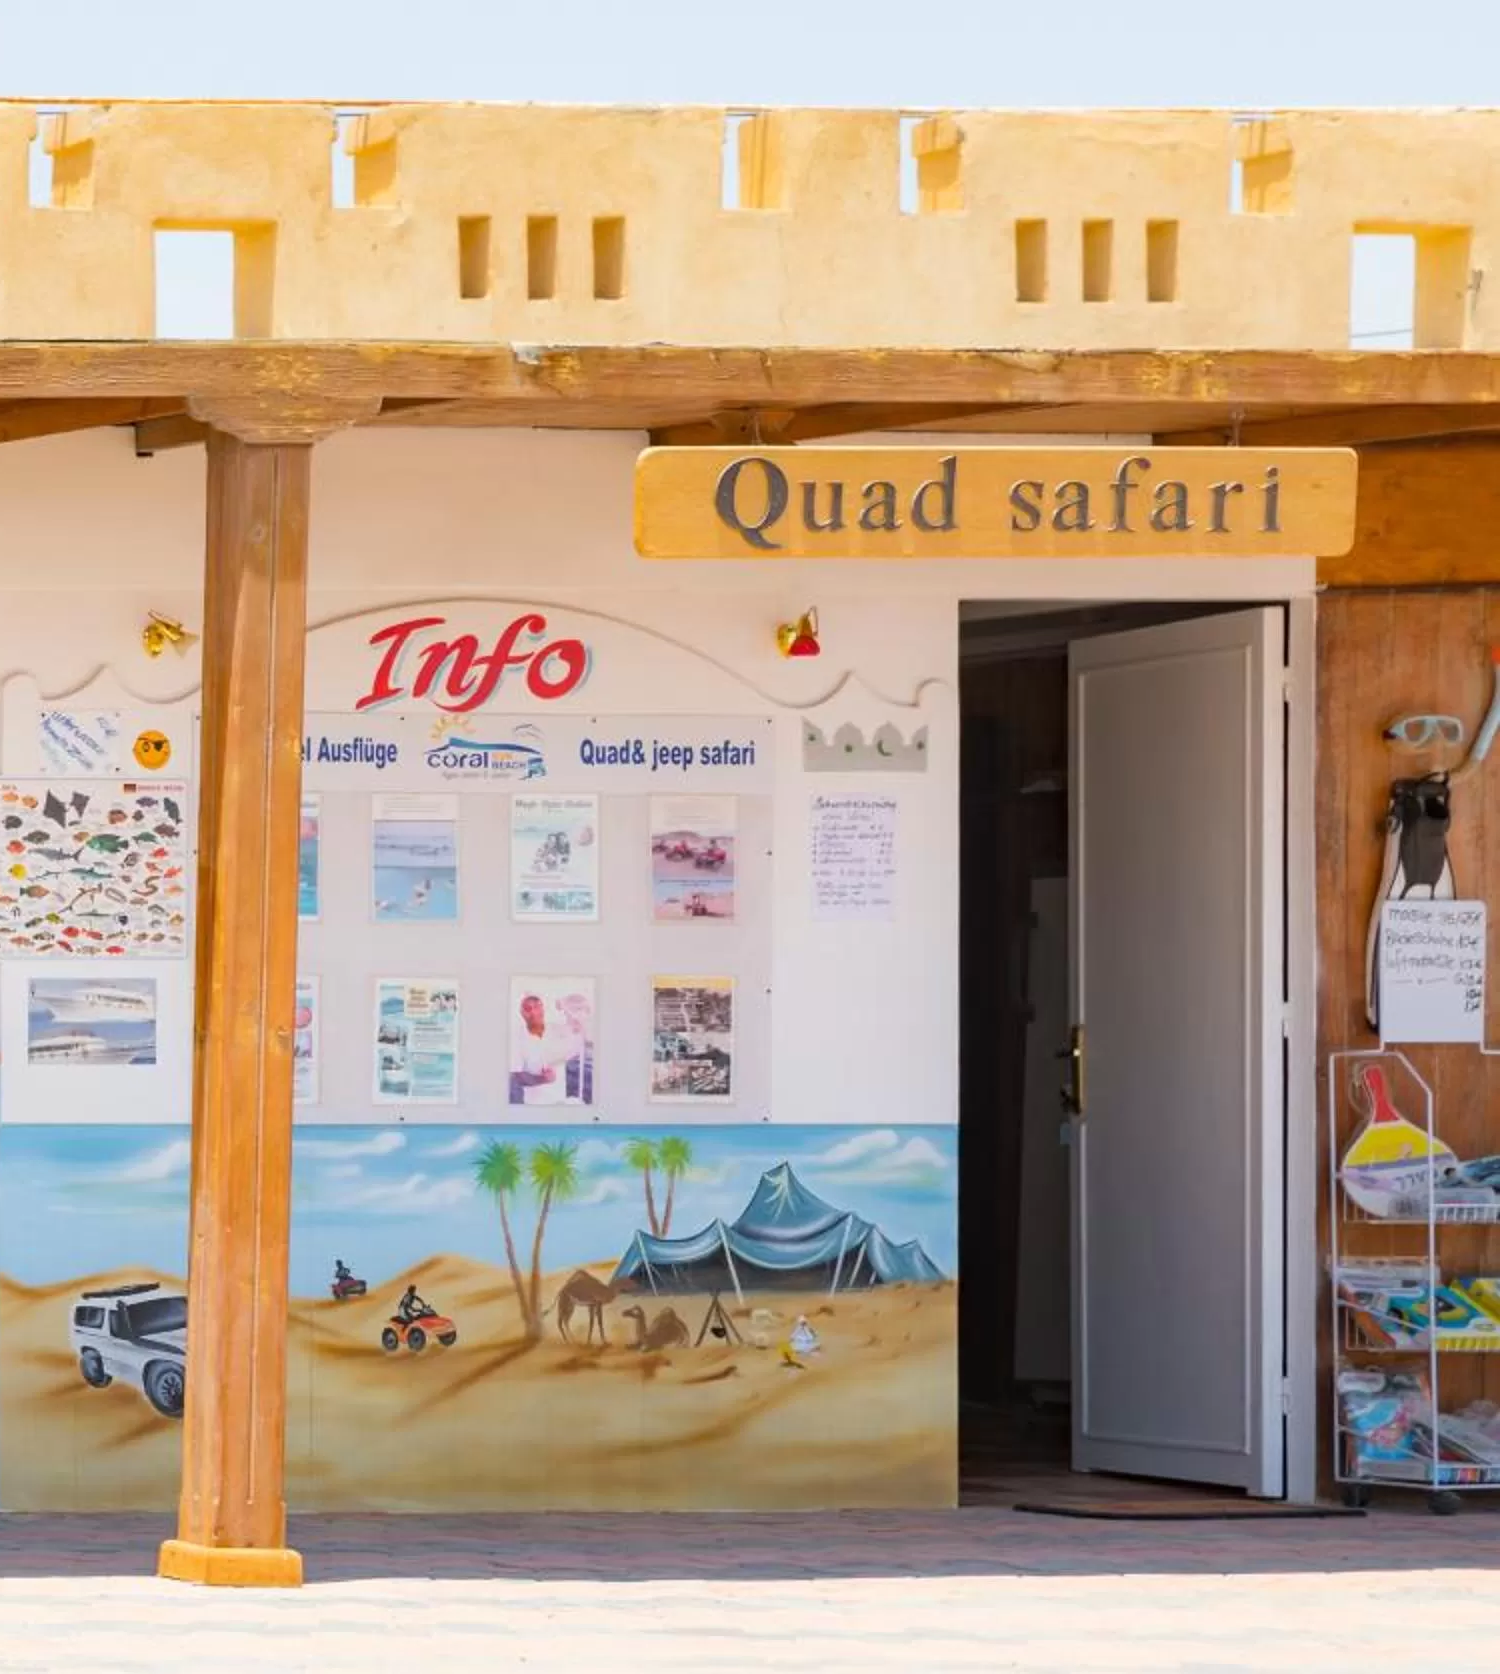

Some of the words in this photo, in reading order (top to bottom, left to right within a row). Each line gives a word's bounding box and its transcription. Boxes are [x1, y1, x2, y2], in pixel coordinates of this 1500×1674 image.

[714, 456, 957, 549] Quad
[1008, 456, 1285, 534] safari
[355, 614, 586, 713] Info
[318, 737, 398, 768] Ausflüge
[427, 751, 488, 769] coral
[580, 739, 645, 767] Quad&
[651, 740, 694, 772] jeep
[699, 740, 755, 766] safari
